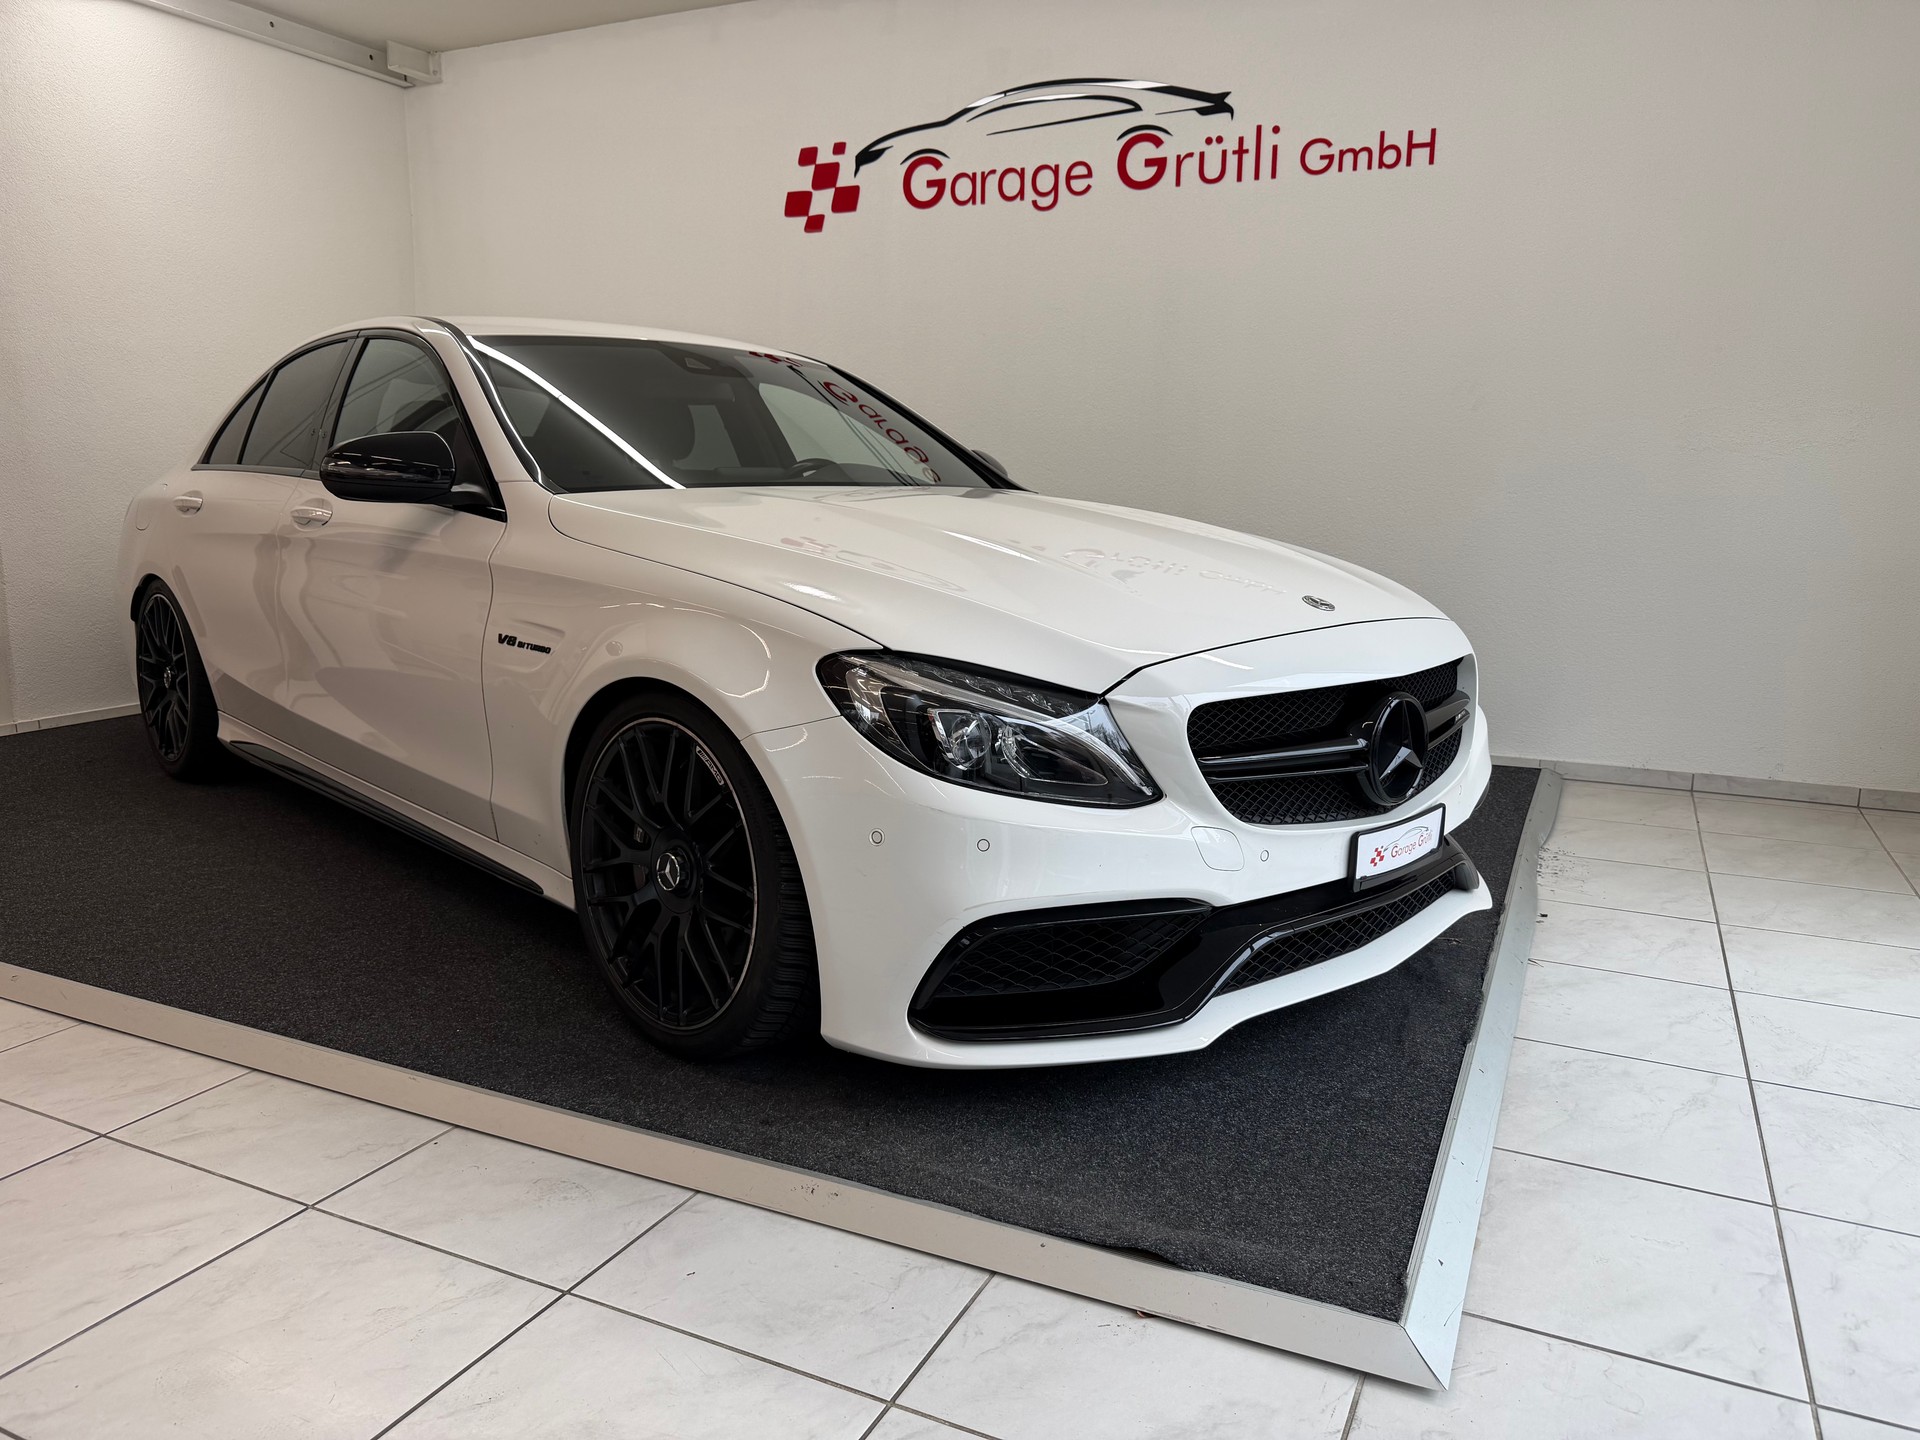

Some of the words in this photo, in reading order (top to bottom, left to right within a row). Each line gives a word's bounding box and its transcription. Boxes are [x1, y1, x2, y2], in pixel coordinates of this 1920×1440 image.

[902, 155, 1093, 212] Garage
[1116, 124, 1281, 191] Grütli
[1299, 127, 1438, 176] GmbH
[498, 633, 517, 646] V8
[1391, 842, 1416, 858] Garage
